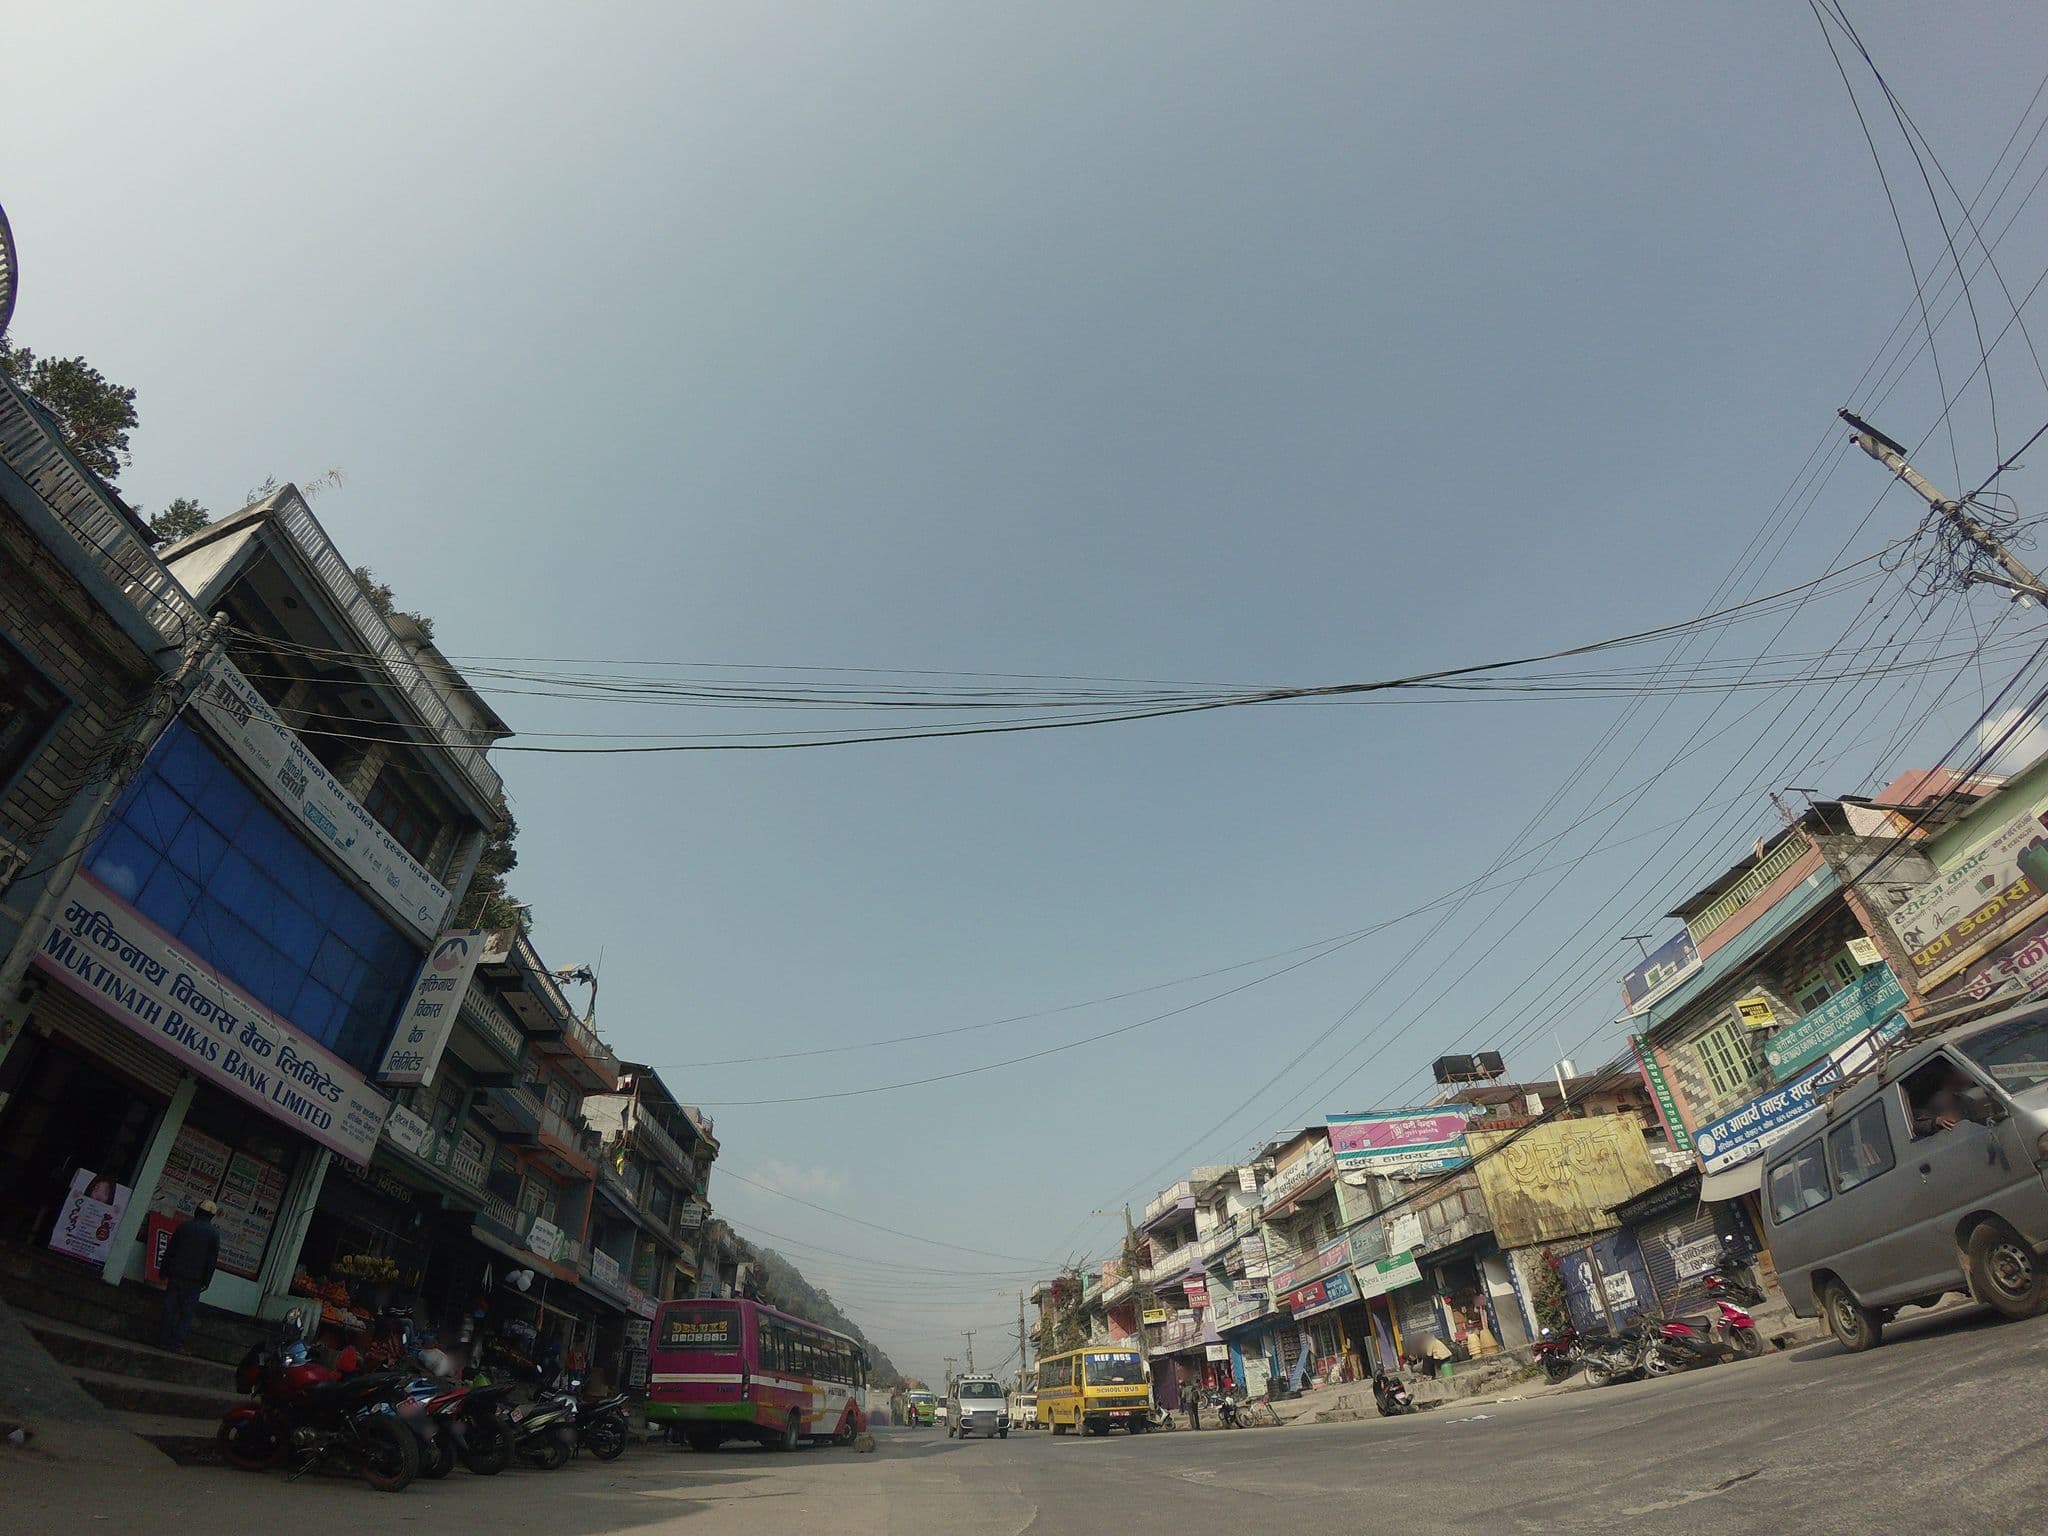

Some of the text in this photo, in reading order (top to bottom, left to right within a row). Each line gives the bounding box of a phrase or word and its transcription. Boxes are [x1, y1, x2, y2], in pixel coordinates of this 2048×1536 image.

[1911, 930, 1953, 965] पूर्ण
[60, 900, 170, 987] मुक्तिनाथ
[168, 972, 239, 1035] विकास
[274, 1048, 344, 1104] लिमिटेड
[413, 999, 443, 1018] विकास
[388, 1050, 423, 1071] लिमिटेड
[1710, 1123, 1728, 1141] एस
[1727, 1102, 1760, 1132] आचार्य
[1759, 1092, 1789, 1116] लाइट
